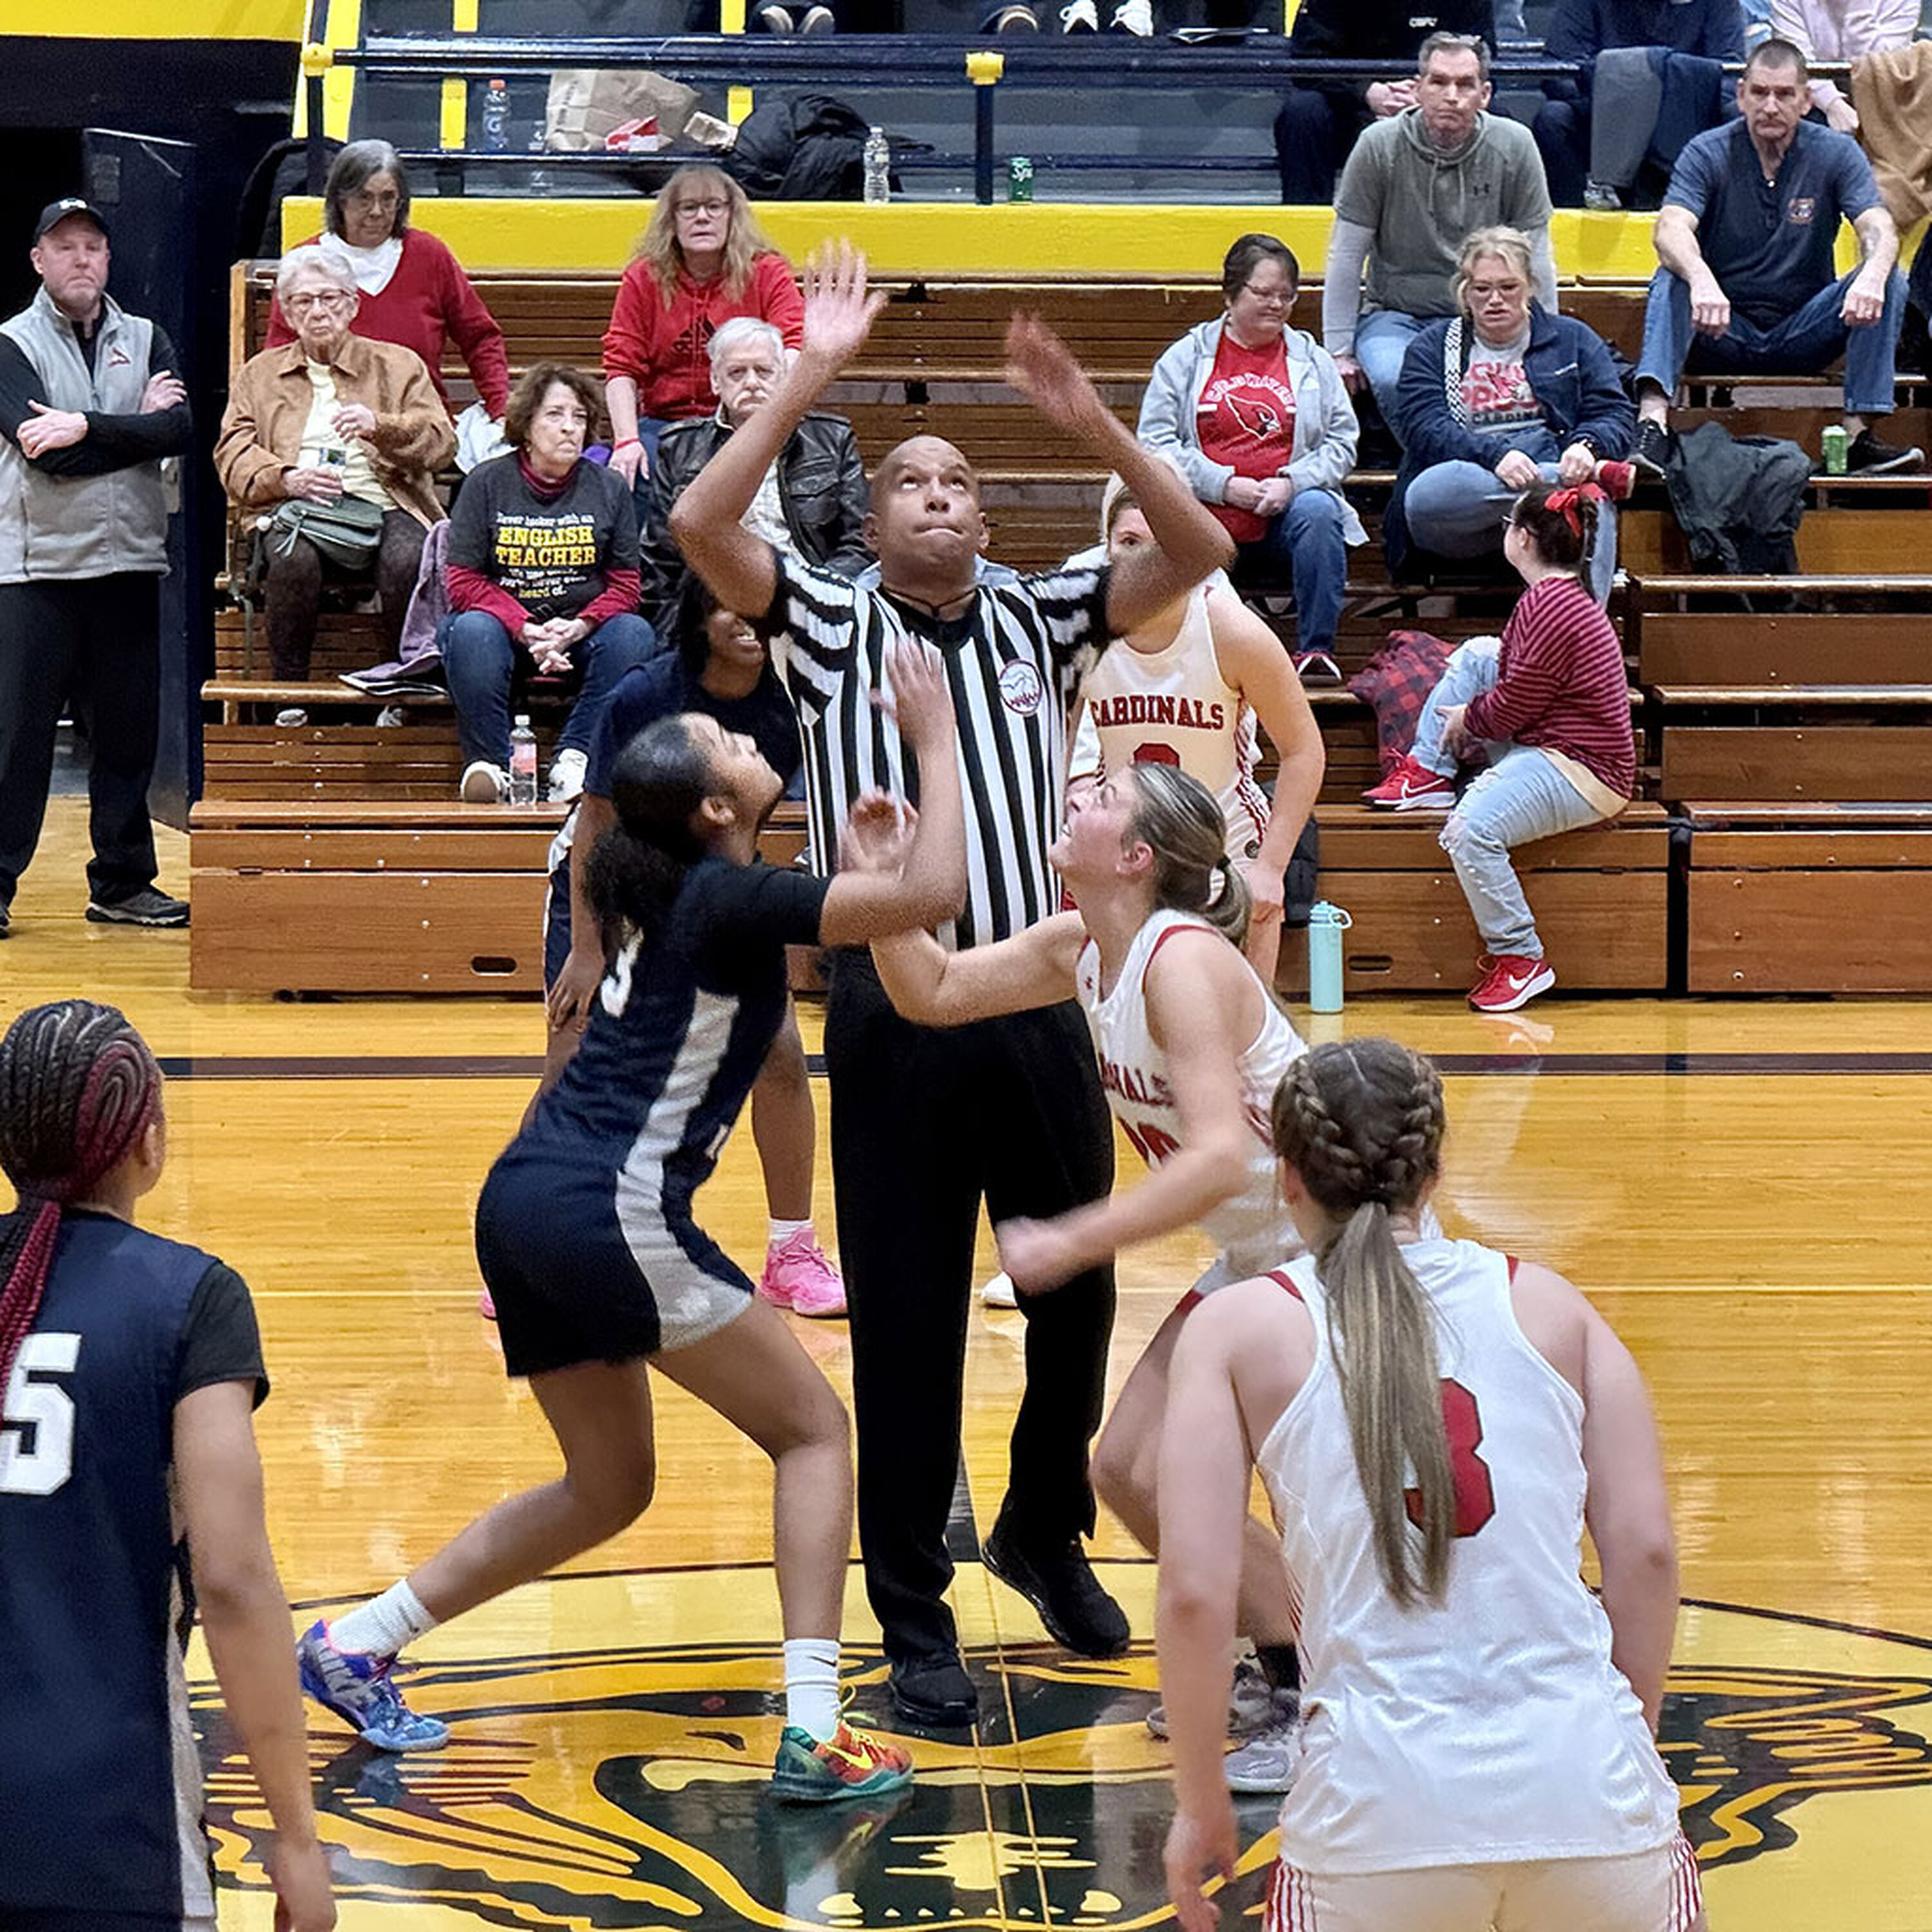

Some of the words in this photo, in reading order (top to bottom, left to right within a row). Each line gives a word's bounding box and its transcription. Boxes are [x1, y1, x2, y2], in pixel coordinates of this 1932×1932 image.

[488, 117, 501, 132] G
[498, 526, 594, 546] ENGLISH
[495, 545, 596, 566] TEACHER
